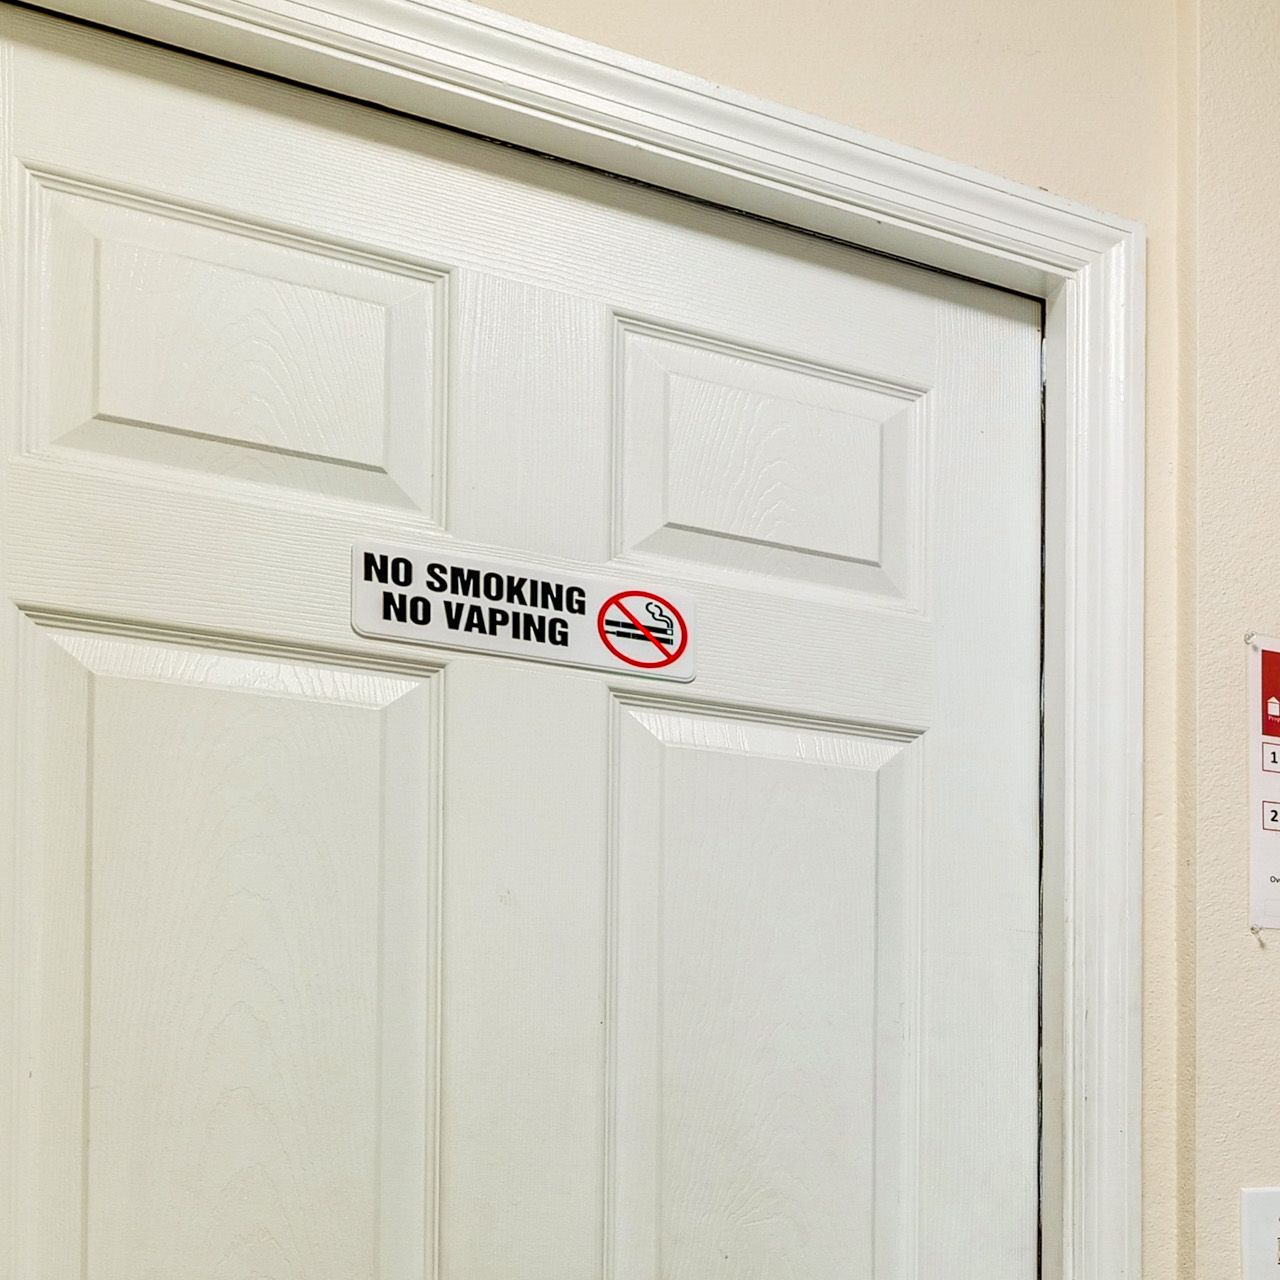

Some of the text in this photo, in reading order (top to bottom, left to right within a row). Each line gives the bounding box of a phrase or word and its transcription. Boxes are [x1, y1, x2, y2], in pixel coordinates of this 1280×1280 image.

[363, 551, 586, 615] NO SMOKING
[382, 591, 569, 647] NO VAPING
[1270, 751, 1278, 764] 1
[1270, 810, 1279, 822] 2
